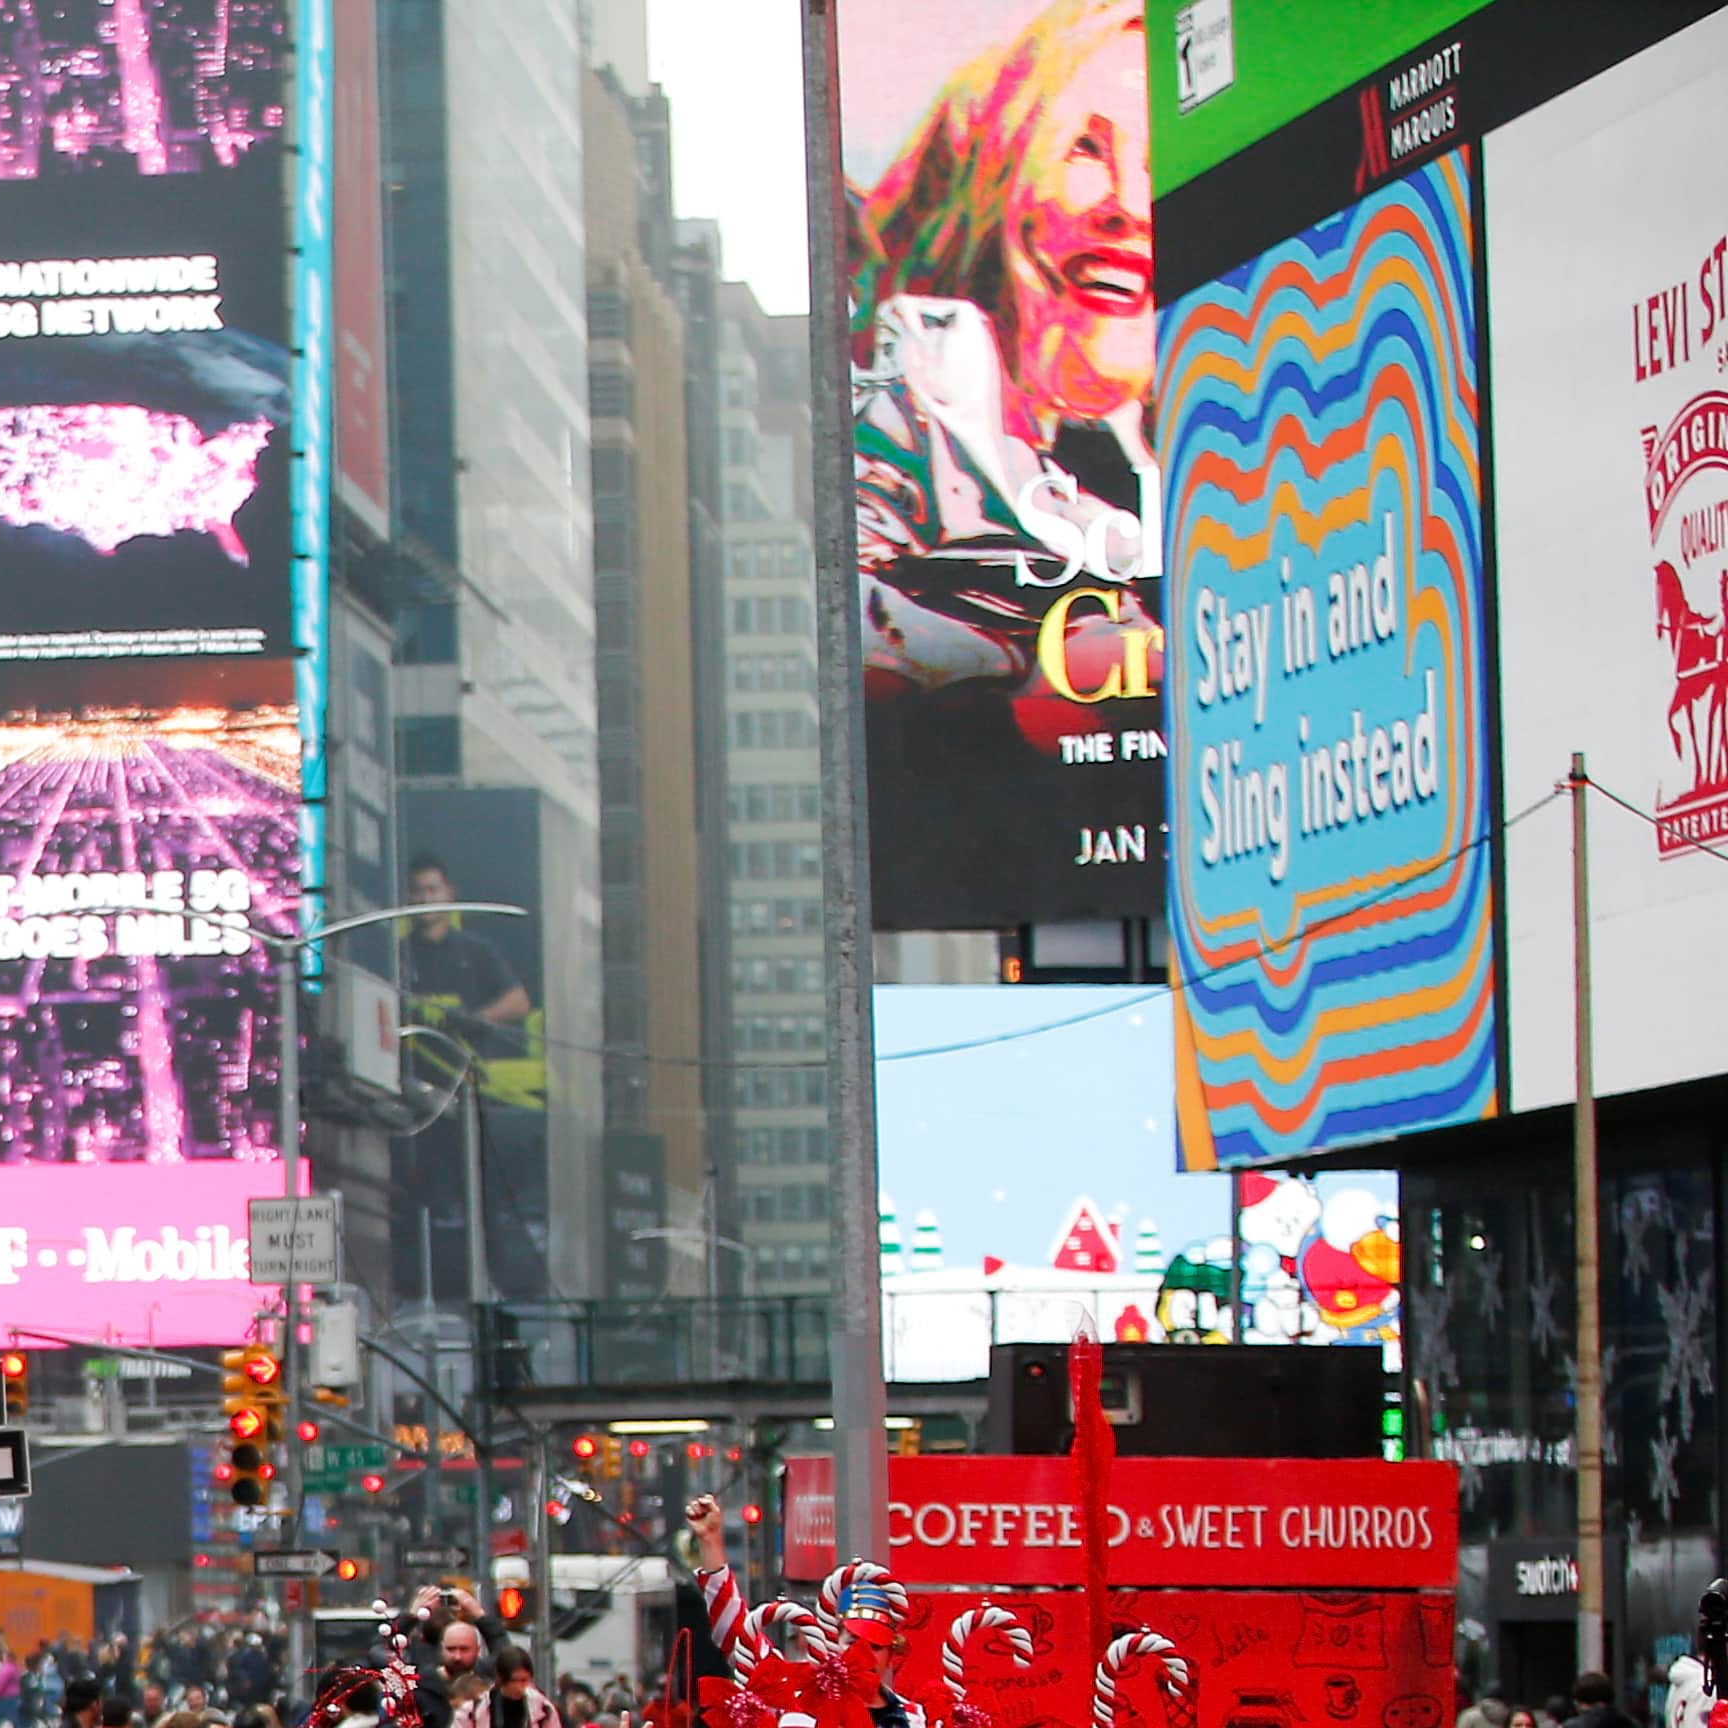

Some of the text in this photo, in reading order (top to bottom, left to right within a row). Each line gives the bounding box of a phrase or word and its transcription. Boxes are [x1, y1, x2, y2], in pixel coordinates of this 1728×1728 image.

[1389, 42, 1462, 111] MARRIOTT
[1391, 96, 1455, 159] MARQUIS
[41, 294, 225, 336] NETWORK
[1633, 281, 1690, 383] LEVI
[1197, 512, 1396, 728] Stay in and
[1059, 735, 1114, 765] THE
[1201, 668, 1438, 884] Sling instead
[1074, 824, 1146, 866] JAN
[116, 911, 251, 957] MILES
[268, 1232, 315, 1250] MUST
[252, 1260, 289, 1273] TURN
[1138, 1517, 1155, 1538] &
[1159, 1504, 1269, 1548] SWEET
[1280, 1505, 1434, 1549] CHURROS
